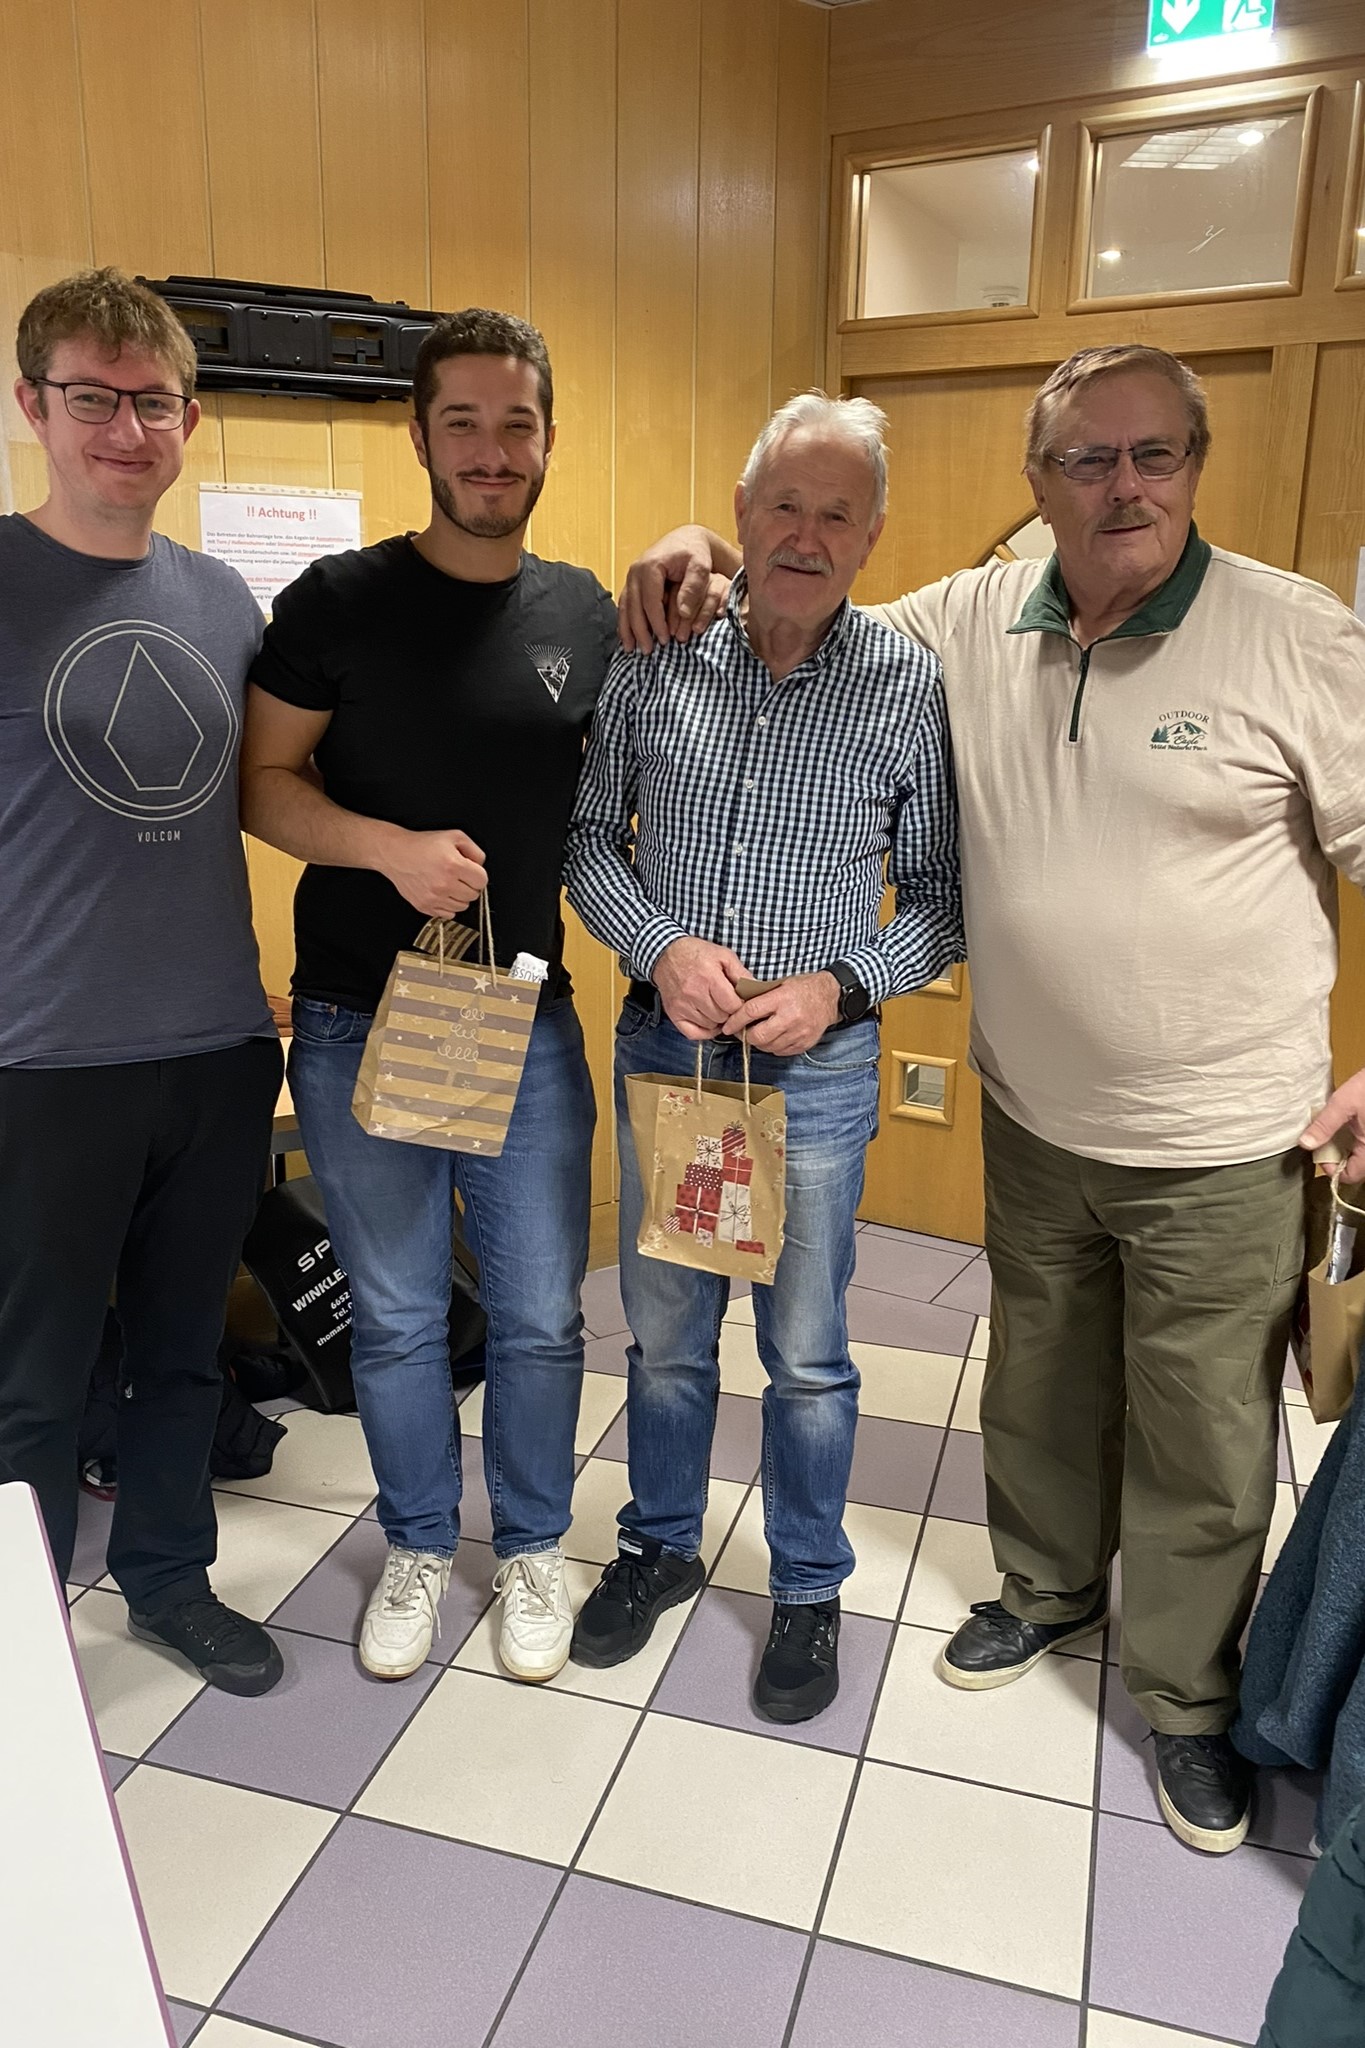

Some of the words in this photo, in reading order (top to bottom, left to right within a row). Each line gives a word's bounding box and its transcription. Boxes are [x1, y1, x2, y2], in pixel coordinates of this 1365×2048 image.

[247, 506, 255, 517] !!
[258, 507, 305, 522] Achtung
[309, 508, 317, 520] !!
[1158, 710, 1210, 724] OUTDOOR
[137, 830, 181, 843] VOLCOM
[292, 1267, 348, 1312] WINKLE
[330, 1291, 351, 1310] 6652
[332, 1307, 349, 1320] Tel.
